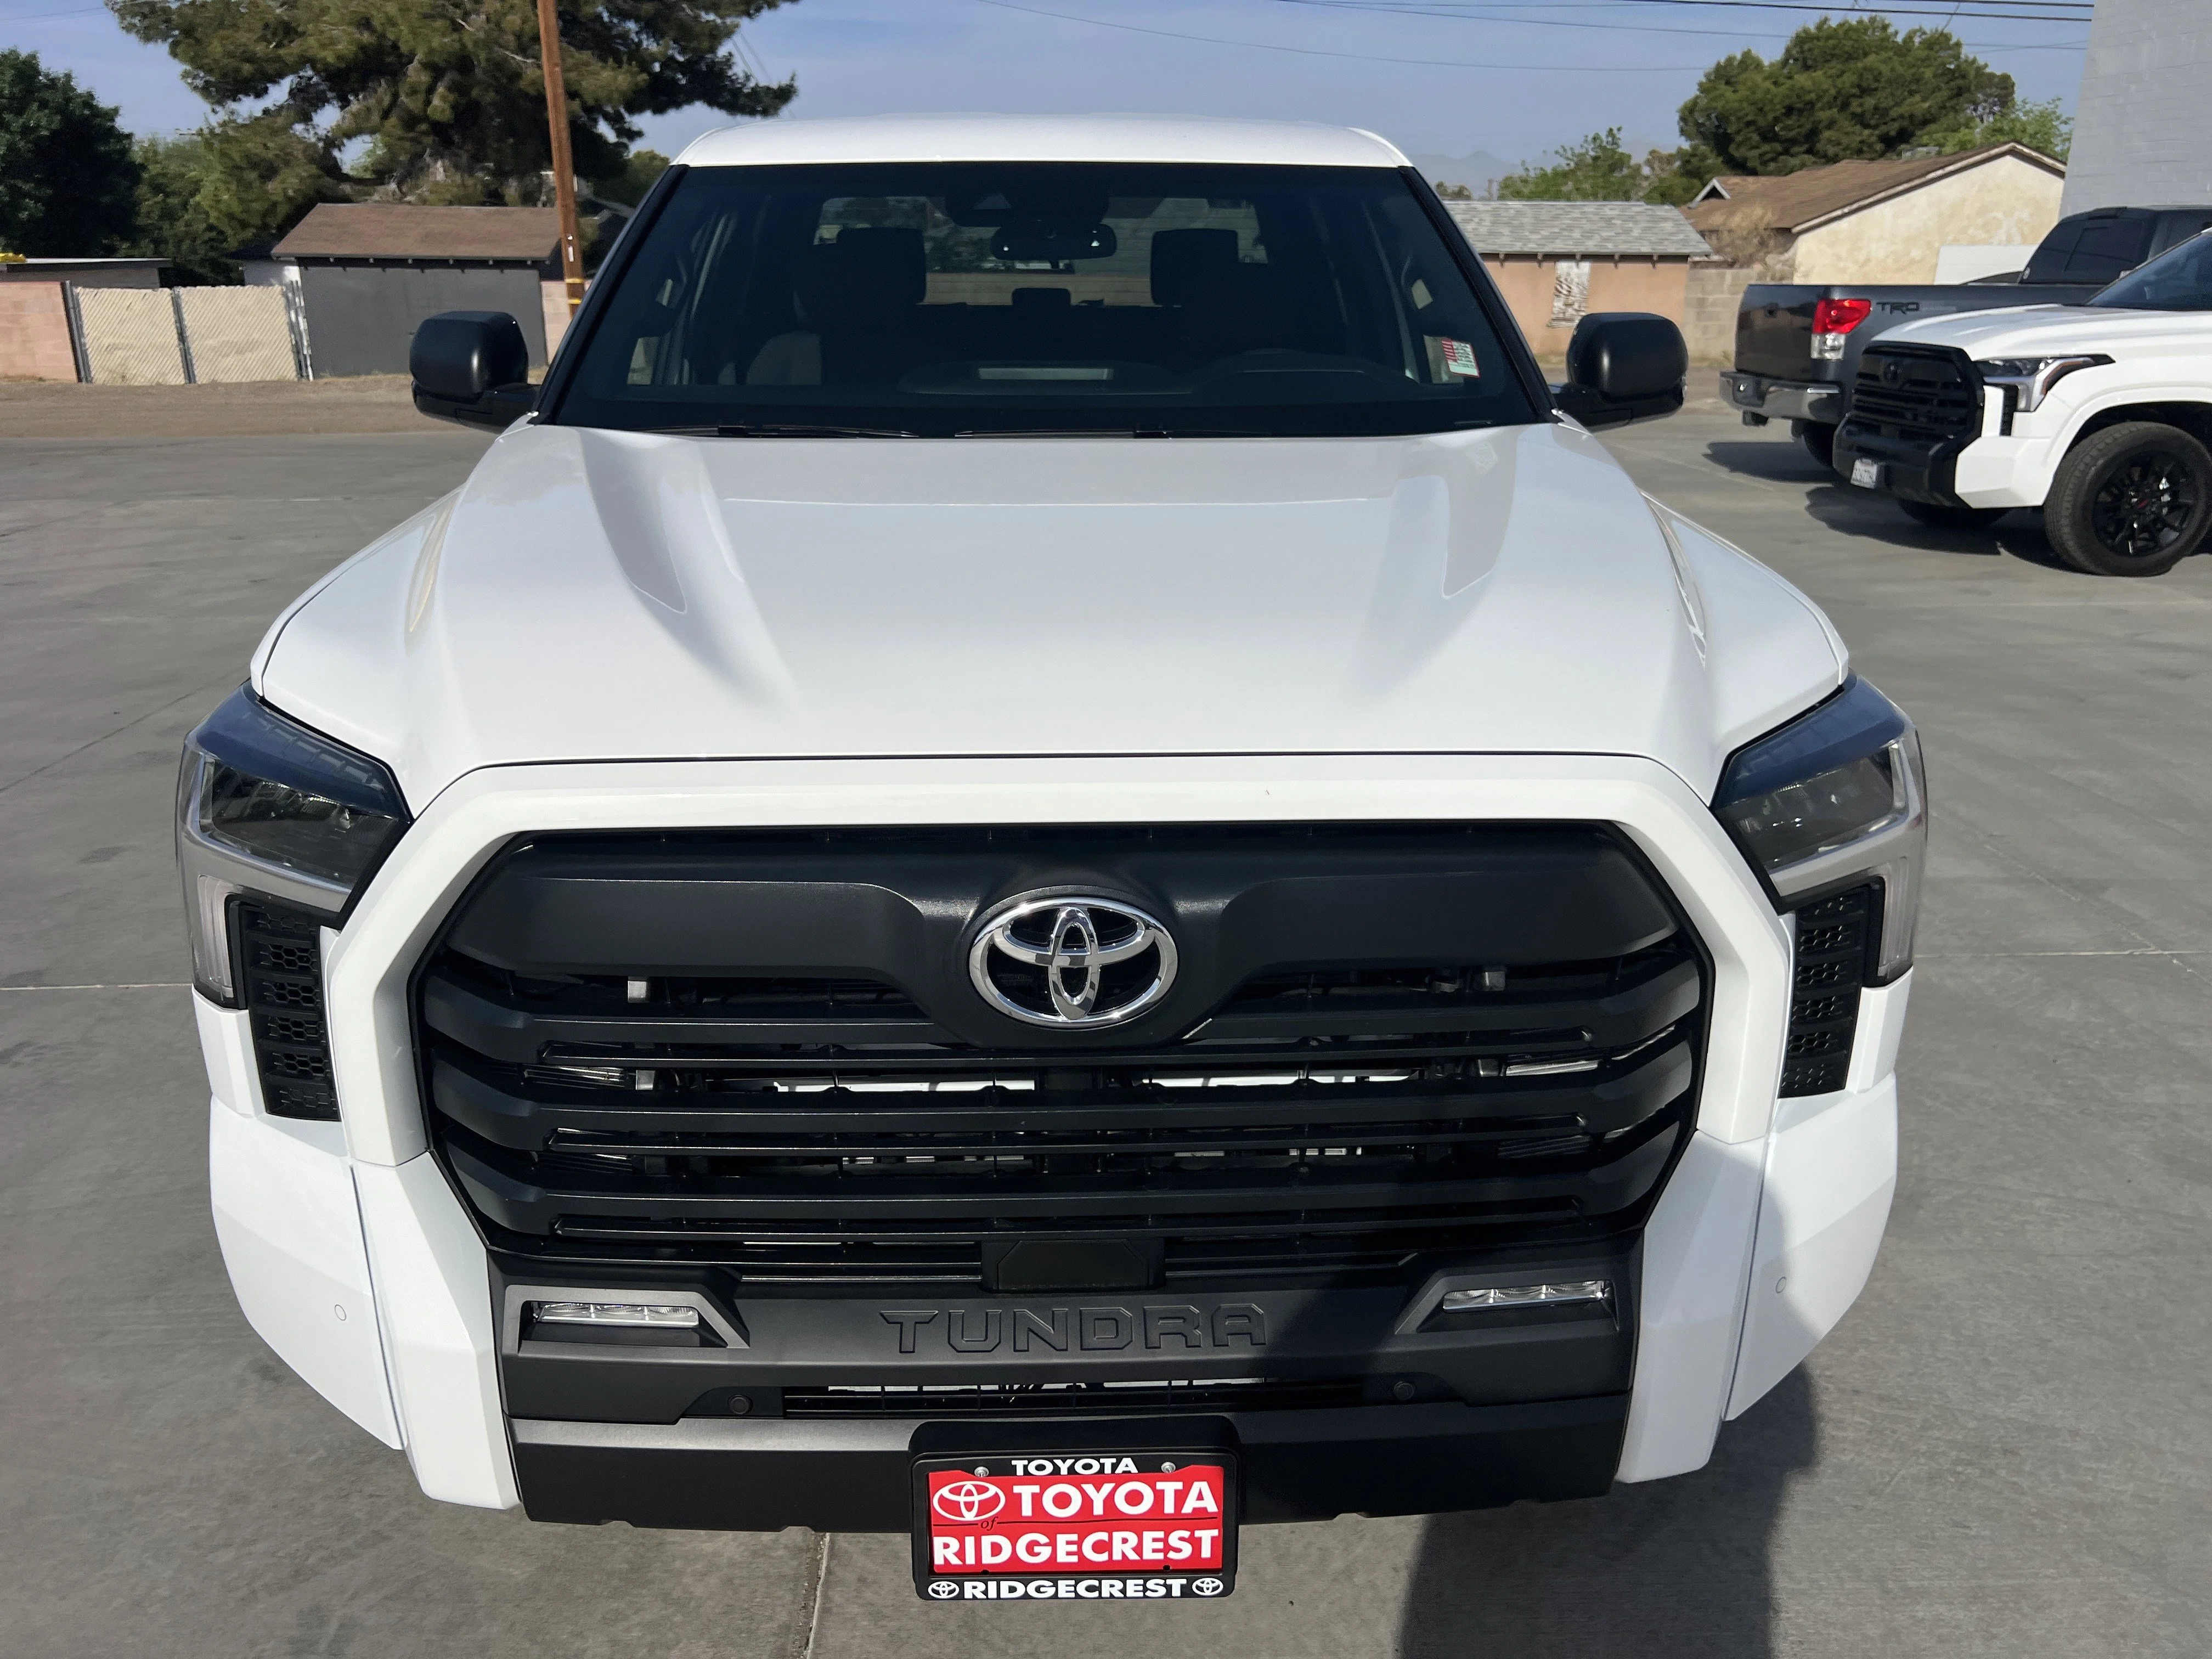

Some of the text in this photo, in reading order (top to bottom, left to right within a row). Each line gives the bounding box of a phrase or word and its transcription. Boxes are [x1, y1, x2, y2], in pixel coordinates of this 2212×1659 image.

[1876, 302, 1920, 315] TRD
[879, 1303, 1266, 1353] TUNDRA
[1012, 1457, 1138, 1476] TOYOTA
[1013, 1481, 1219, 1517] TOYOTA
[980, 1516, 999, 1531] of
[933, 1529, 1219, 1566] RIDGECREST
[963, 1579, 1187, 1600] RIDGECREST
